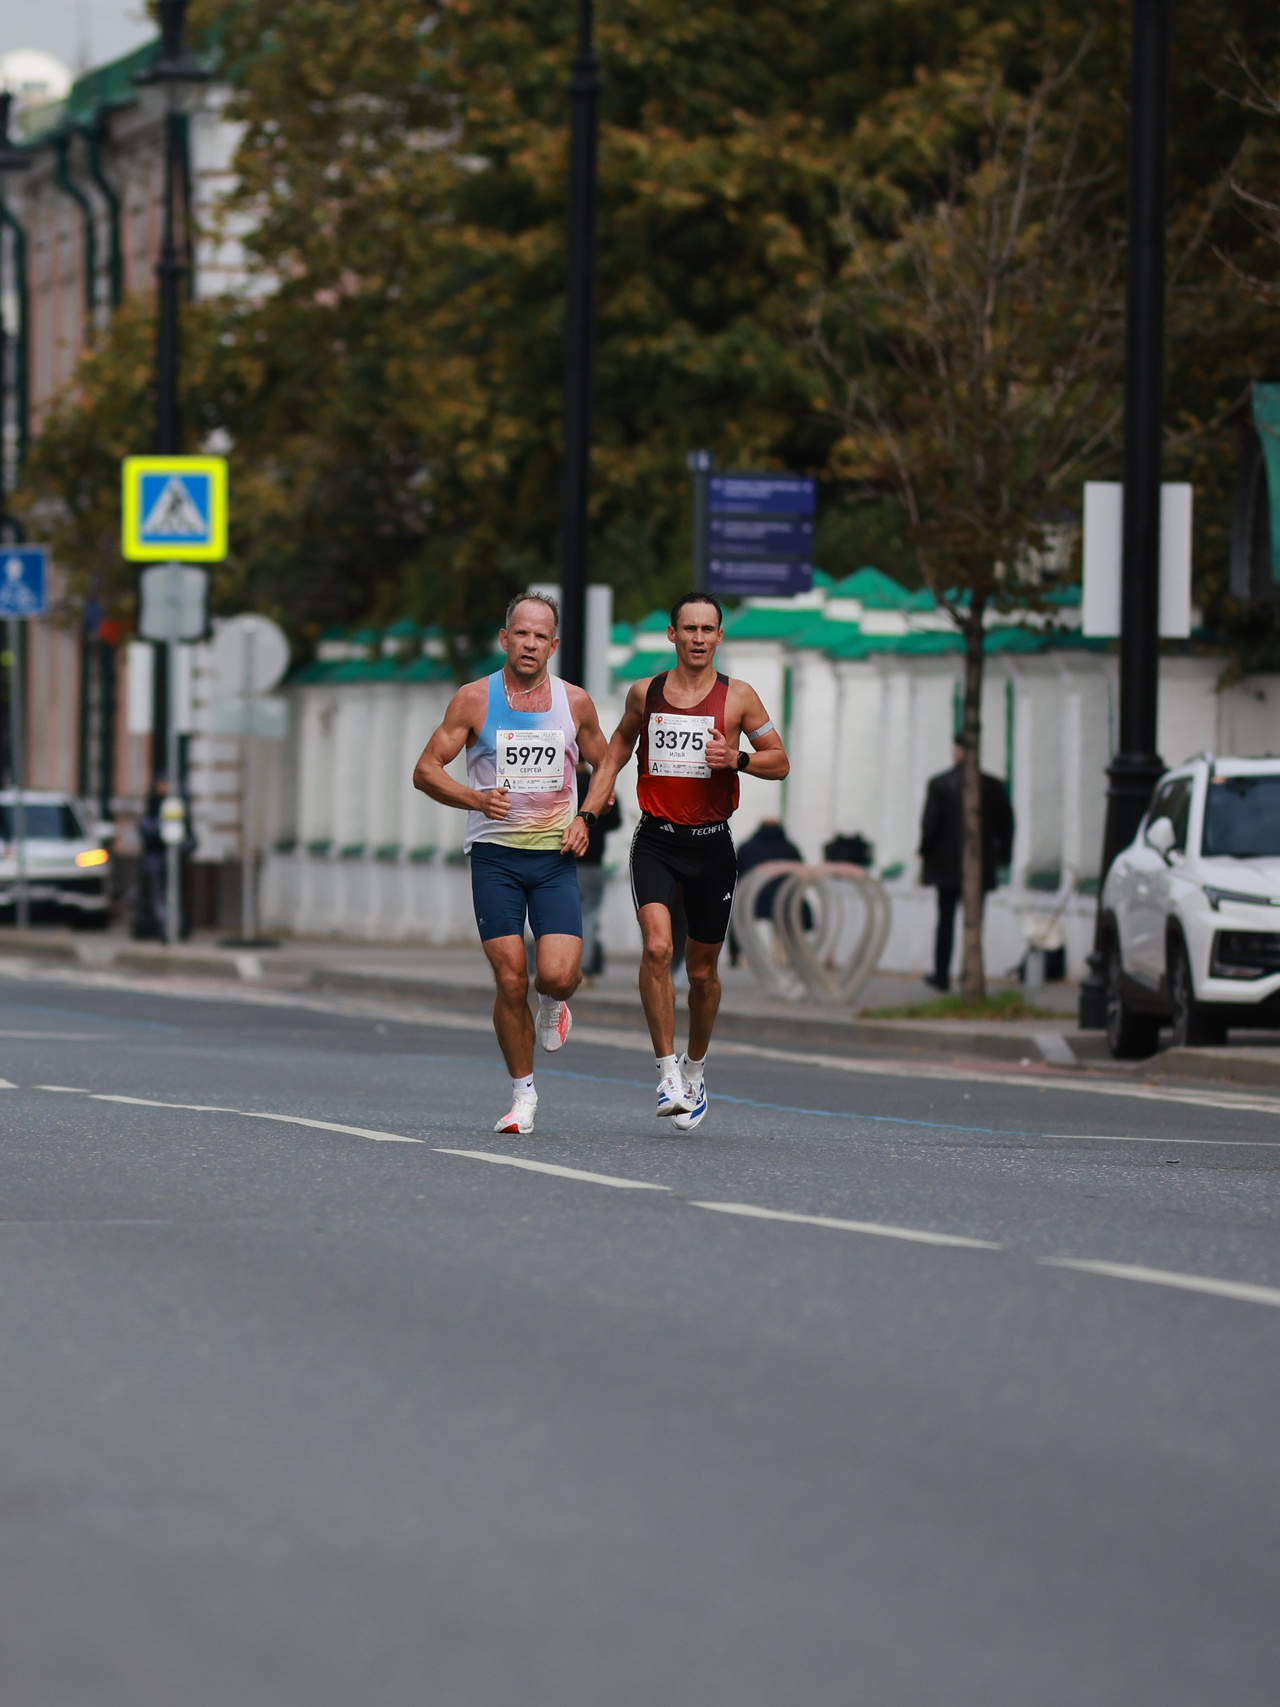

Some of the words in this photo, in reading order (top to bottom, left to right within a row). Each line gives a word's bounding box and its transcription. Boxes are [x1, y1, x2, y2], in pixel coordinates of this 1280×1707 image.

[655, 730, 703, 750] 3375
[506, 747, 556, 765] 5979
[691, 823, 725, 836] TECHFIT
